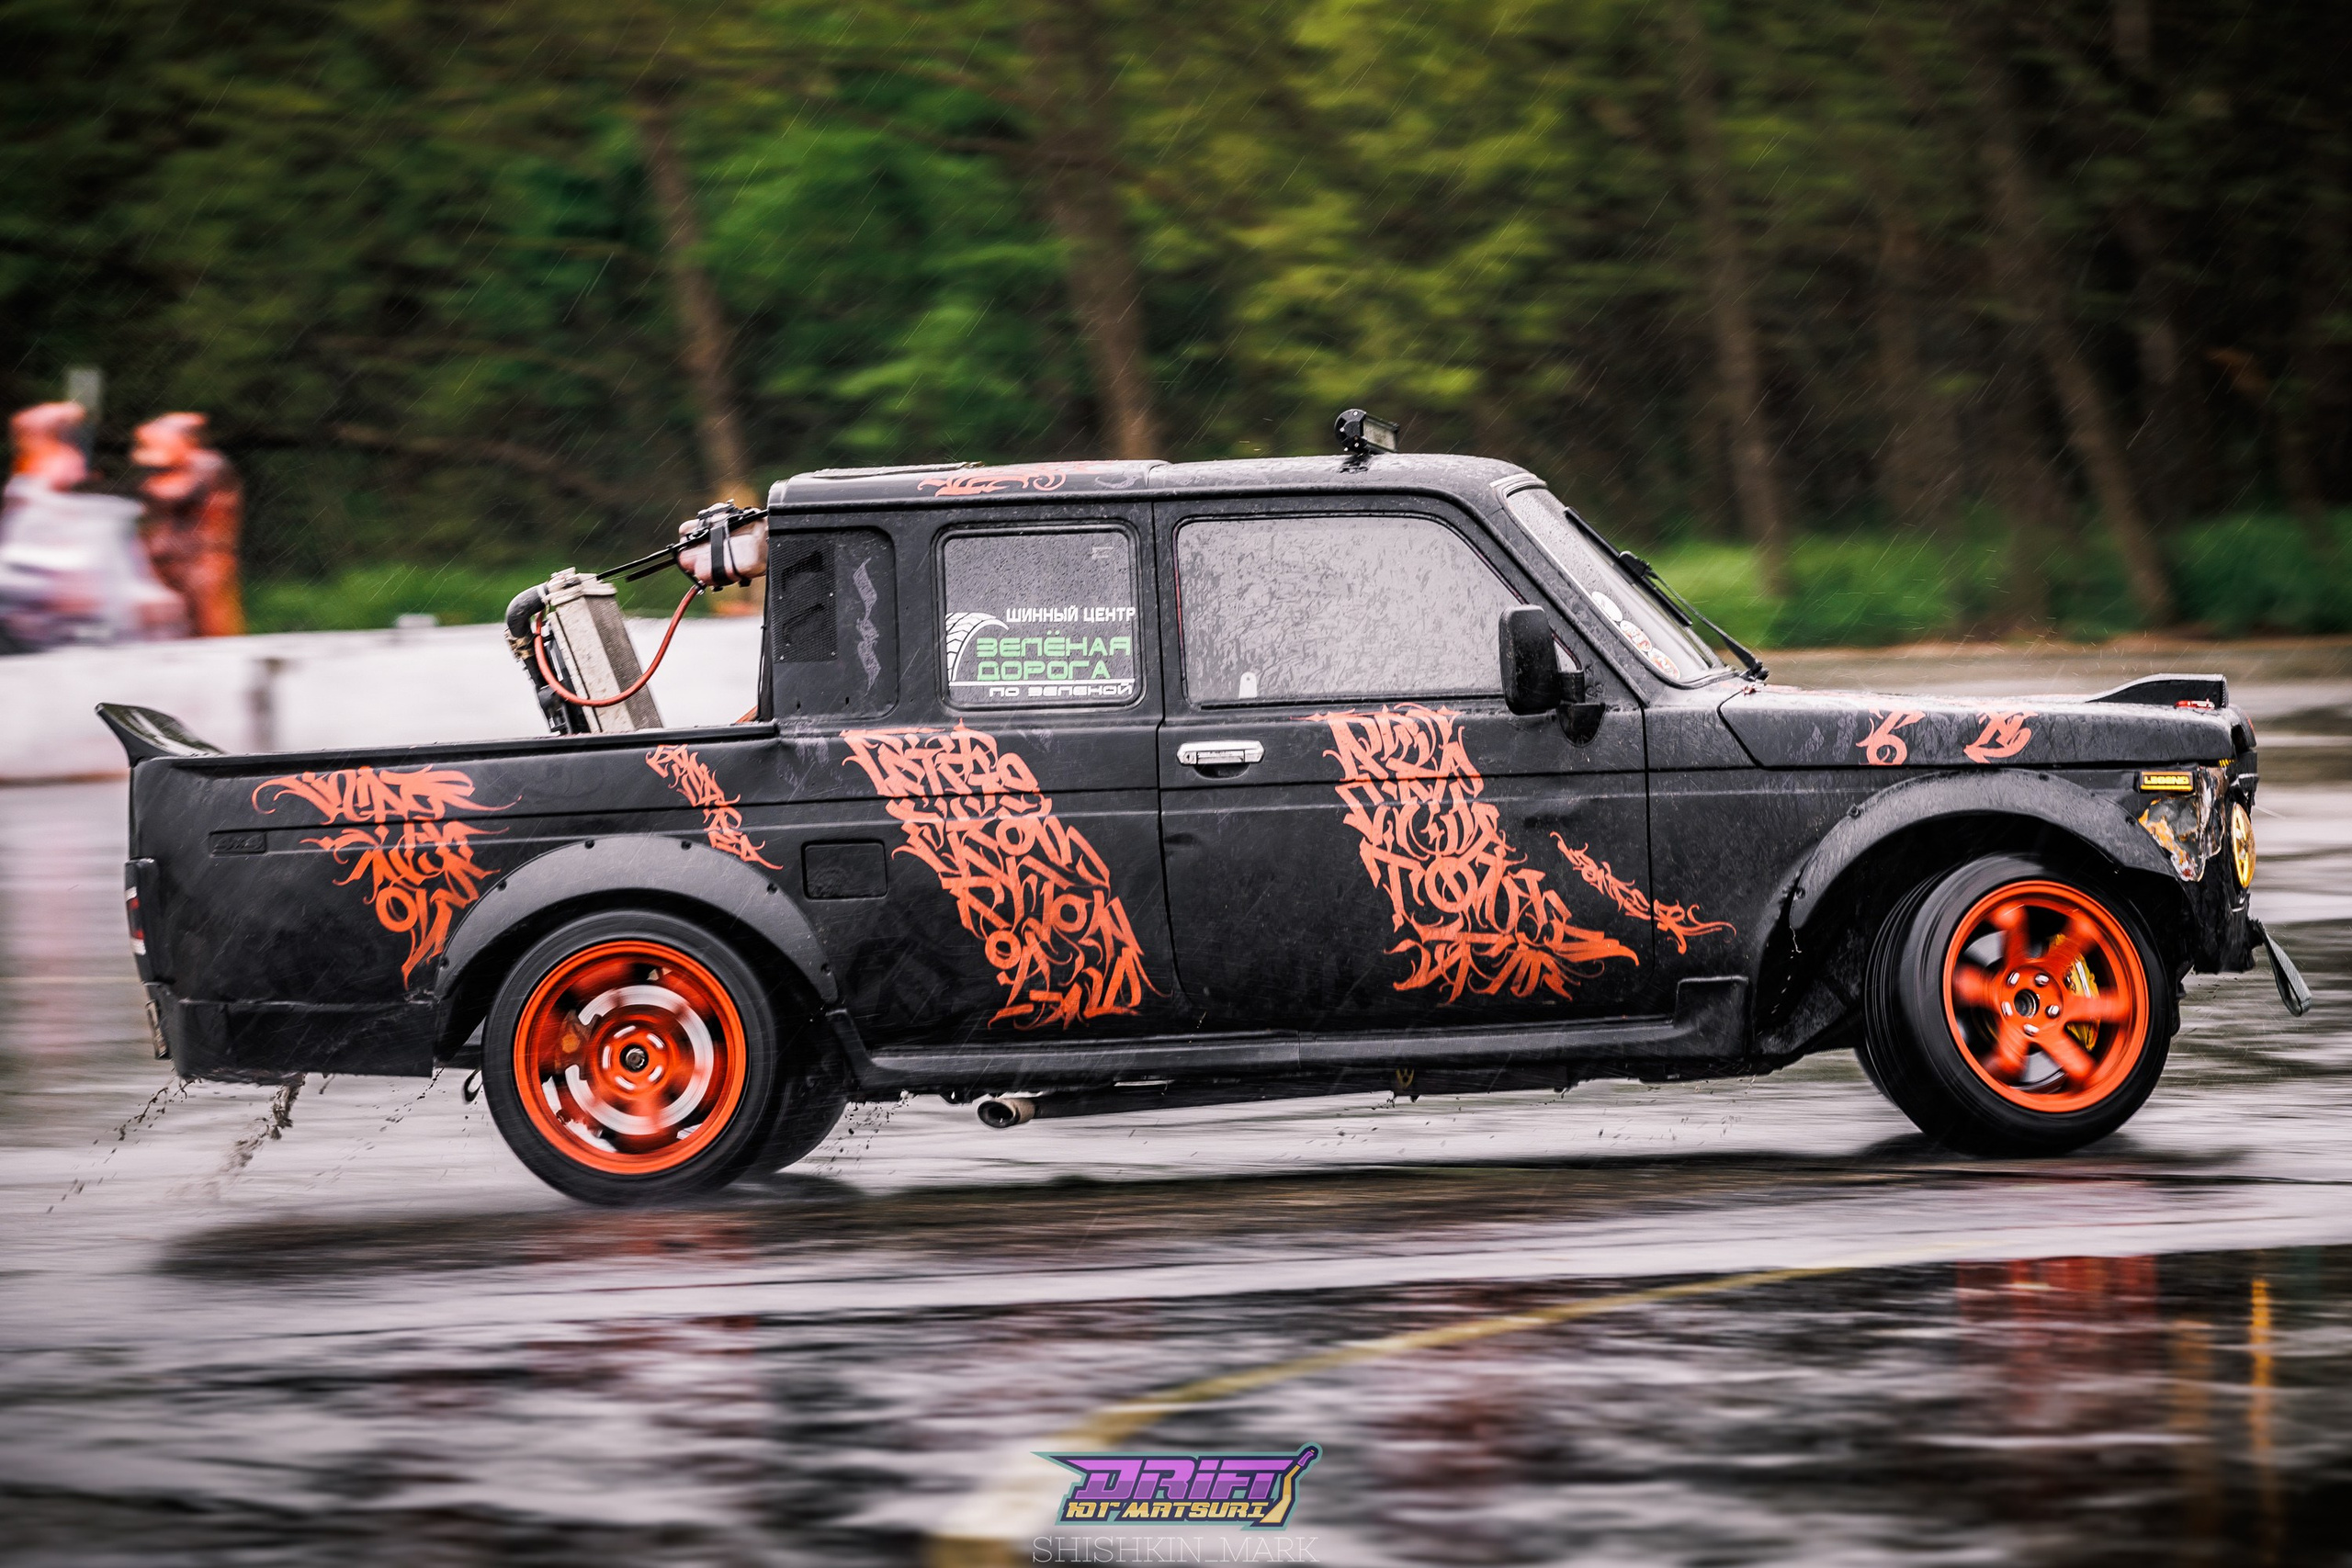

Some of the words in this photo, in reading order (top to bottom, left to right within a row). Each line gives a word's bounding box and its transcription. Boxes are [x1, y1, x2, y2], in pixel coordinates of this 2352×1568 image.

[1006, 605, 1079, 624] ШИННЫЙ
[1083, 606, 1136, 623] ЦЕНТР
[976, 630, 1131, 657] ЗЕЛЁНАЯ
[977, 660, 1111, 681] ДОРОГА
[989, 687, 1020, 697] ПО
[2144, 776, 2189, 784] LEGEND
